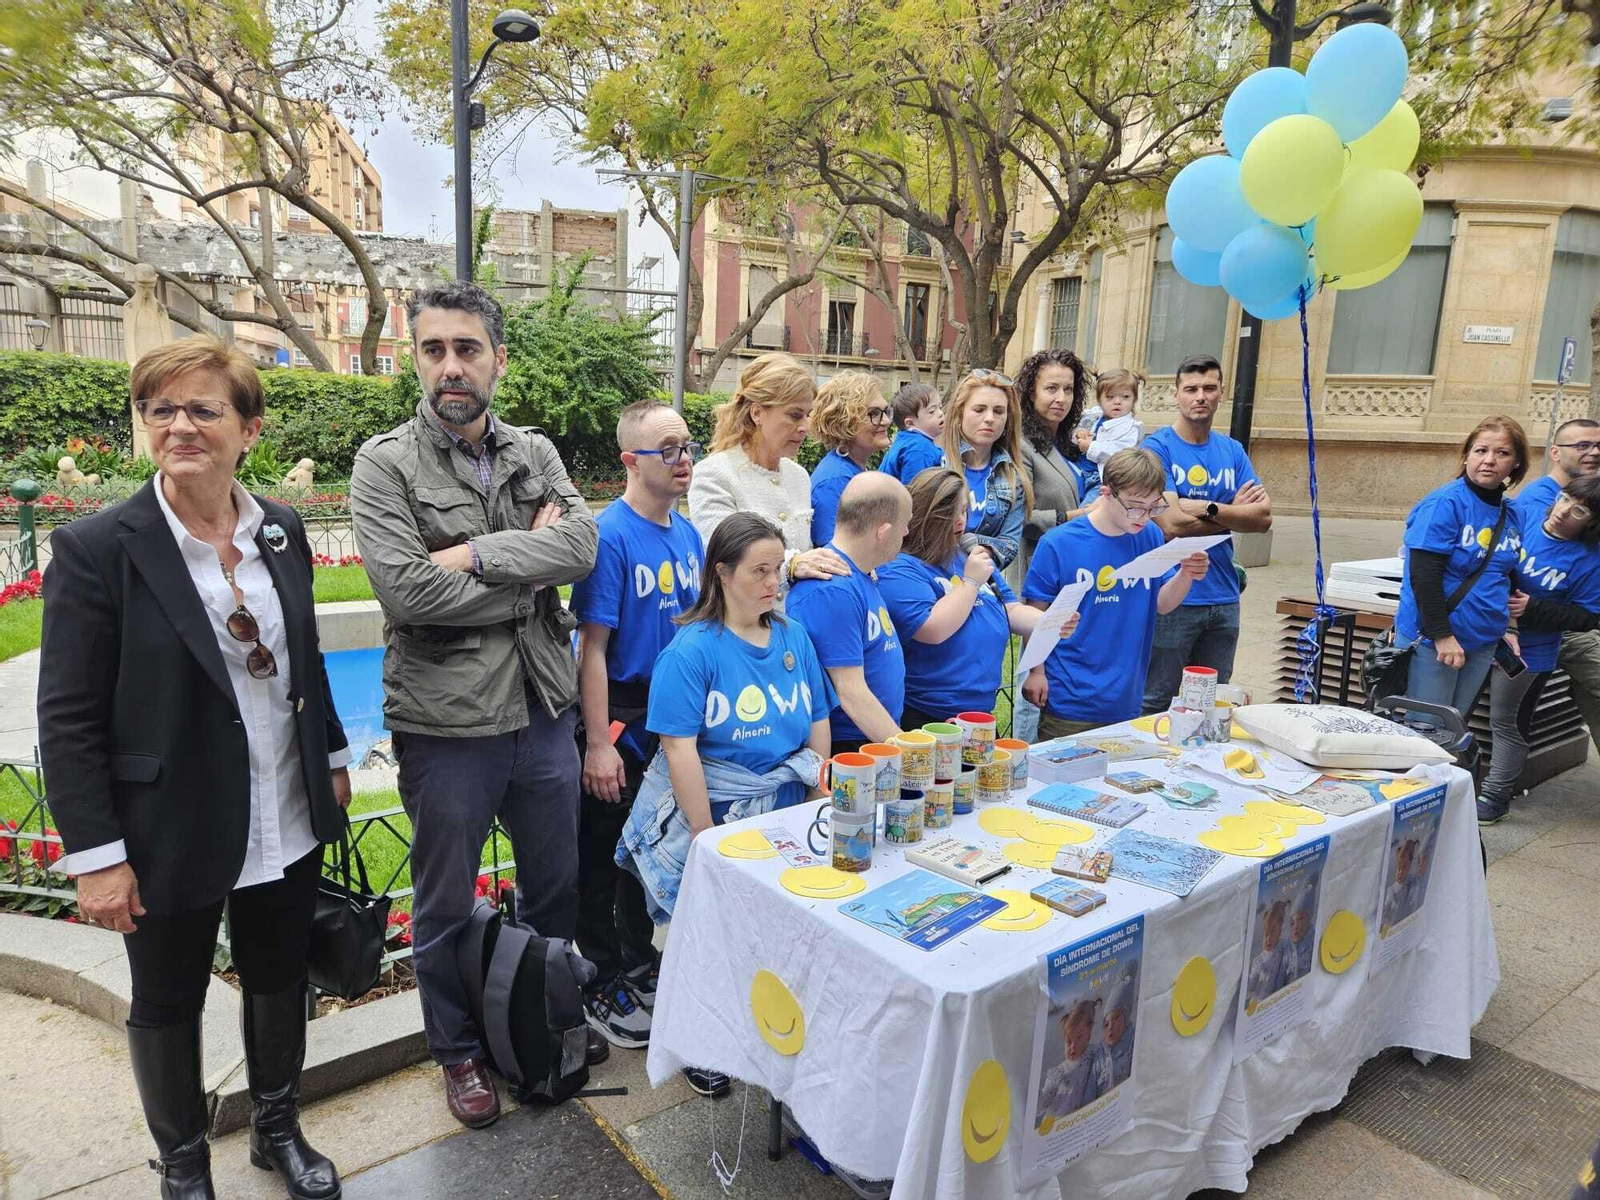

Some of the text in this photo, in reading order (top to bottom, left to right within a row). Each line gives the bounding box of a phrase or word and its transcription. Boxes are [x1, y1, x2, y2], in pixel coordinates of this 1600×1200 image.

[1171, 463, 1236, 491] DOWN
[1053, 923, 1140, 968] DÍA INTERNACIONAL DEL
[1060, 937, 1134, 977] SÍNDROME DE DOWN
